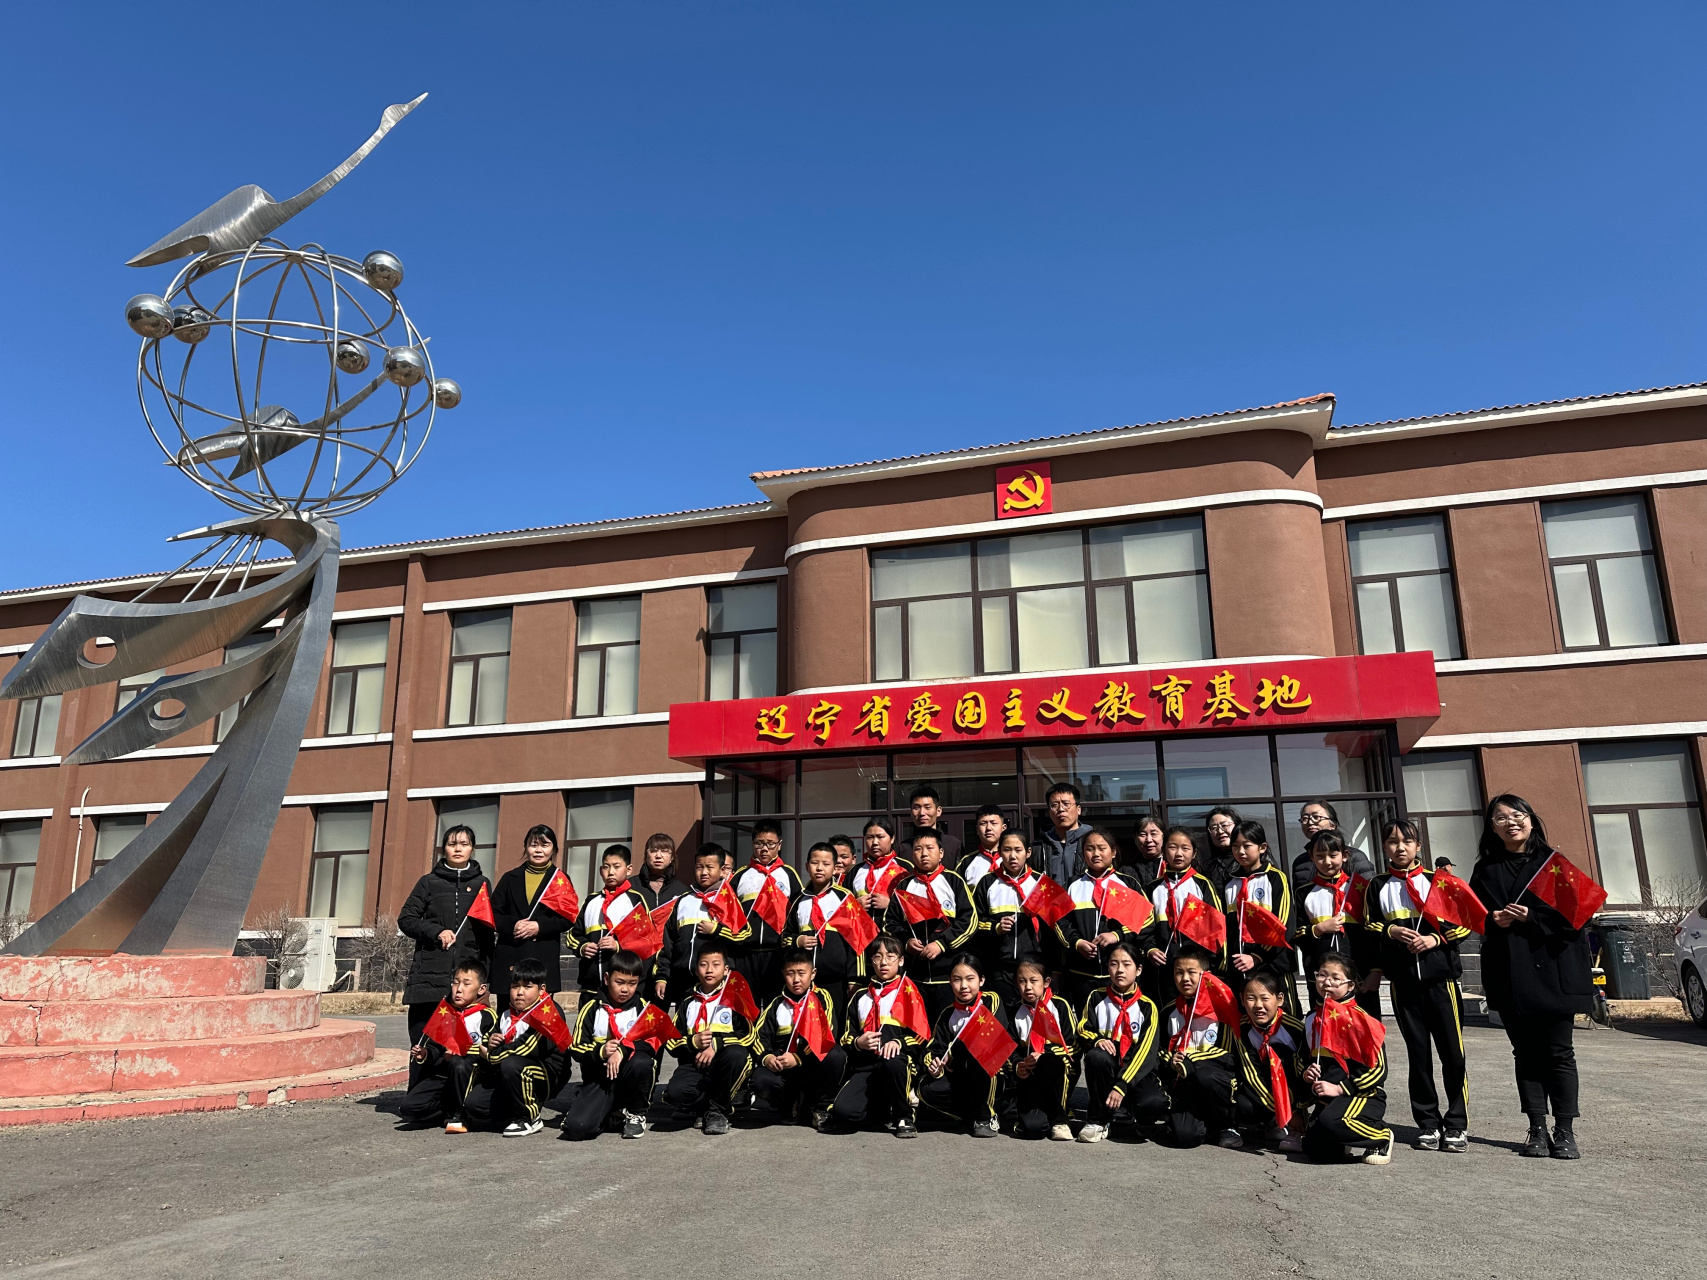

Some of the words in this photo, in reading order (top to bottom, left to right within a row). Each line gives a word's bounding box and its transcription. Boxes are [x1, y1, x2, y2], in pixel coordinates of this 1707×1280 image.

[755, 669, 1314, 742] 辽宁省爱国主义教育基地
